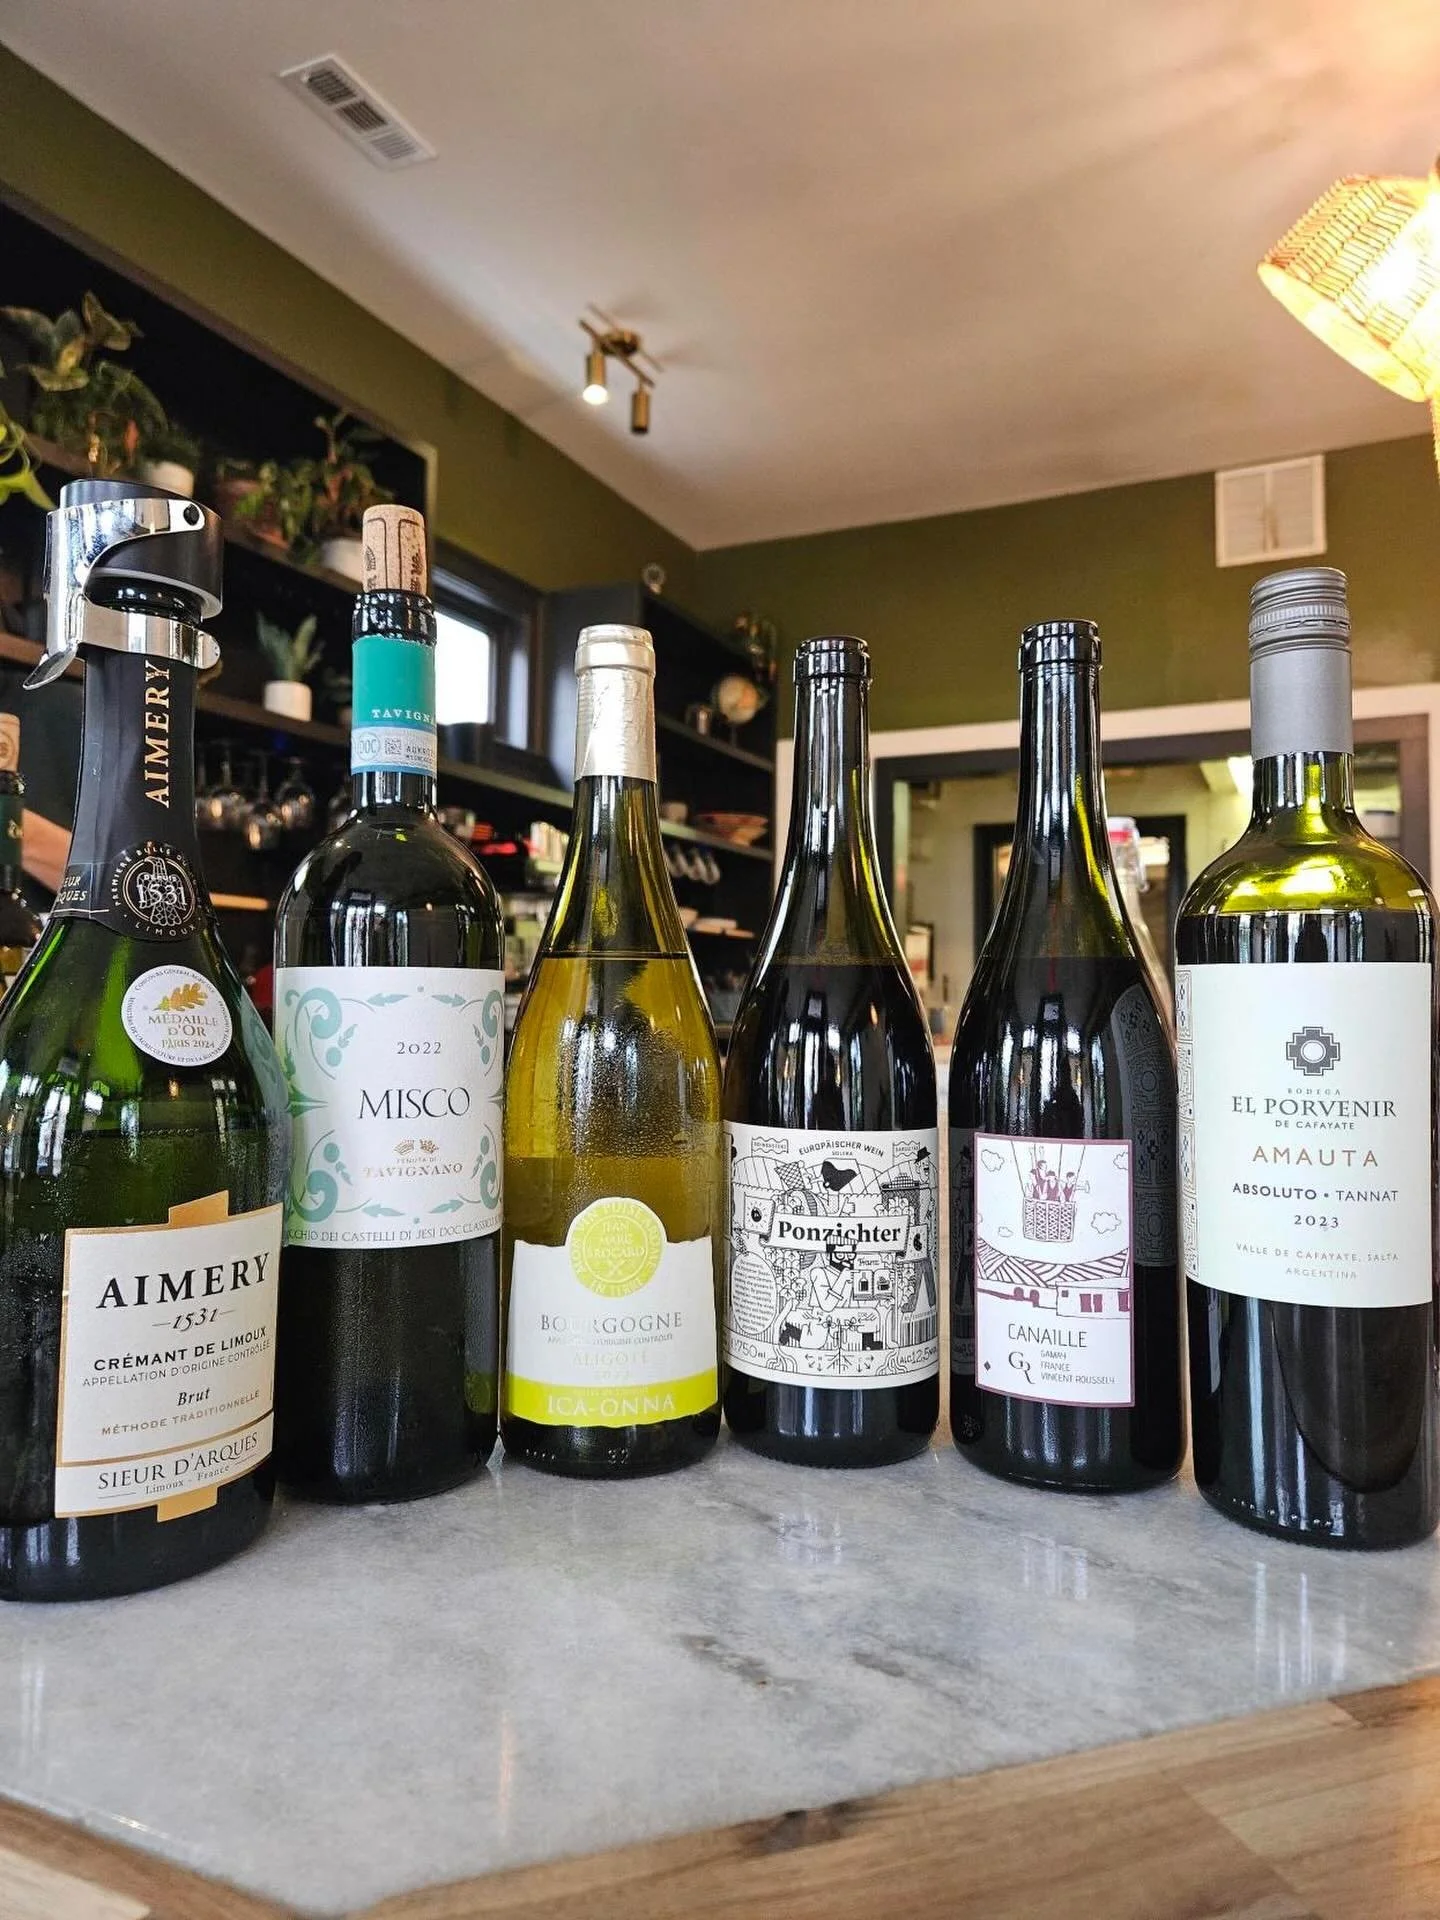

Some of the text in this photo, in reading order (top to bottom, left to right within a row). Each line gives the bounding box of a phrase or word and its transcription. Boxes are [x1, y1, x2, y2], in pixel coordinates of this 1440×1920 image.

[144, 659, 171, 808] AIMERY
[136, 883, 187, 909] 1531
[135, 923, 196, 937] LIMOUX
[147, 1012, 218, 1027] MÉDAILLE
[168, 1024, 207, 1037] D'OR
[162, 1039, 191, 1049] PARIS
[192, 1039, 216, 1049] 2024
[396, 1041, 442, 1055] 2022
[1287, 1087, 1342, 1097] BODEGA
[359, 1086, 471, 1120] MISCO
[1231, 1096, 1397, 1119] EL PORVENIR
[1275, 1119, 1356, 1131] DE CAFAYATE
[863, 1144, 884, 1158] WEIN
[1252, 1146, 1379, 1168] AMAUTA
[363, 1162, 463, 1178] TAVIGNANO
[1232, 1183, 1399, 1202] ABSOLUTO TANNAT
[1294, 1214, 1339, 1229] 2023
[321, 1231, 339, 1242] DEI
[341, 1230, 396, 1242] CASTELLI
[400, 1230, 412, 1241] DI
[416, 1227, 436, 1239] JESI
[778, 1220, 901, 1244] Ponzichter
[1236, 1243, 1269, 1256] VALLE
[1274, 1246, 1290, 1258] DE
[1367, 1251, 1400, 1263] SALTA
[95, 1252, 270, 1309] AIMERY
[1285, 1267, 1358, 1281] ARGENTINA
[172, 1308, 219, 1332] 1531
[541, 1311, 683, 1335] BORGOGNE
[1008, 1323, 1088, 1348] CANAILLE
[94, 1326, 268, 1372] CRÉMANT DE LIMOUX
[82, 1368, 167, 1388] APPELLATION
[170, 1355, 228, 1378] D'ORIGINE
[1041, 1360, 1071, 1372] FRANCE
[1041, 1371, 1073, 1383] VINCENT
[177, 1387, 211, 1406] Brut
[547, 1393, 676, 1417] ICA-ONNA
[101, 1389, 260, 1437] MÉTHODE TRADITIONNELLE
[98, 1431, 259, 1491] SIEUR D'ARQUES
[145, 1478, 184, 1496] Limoux
[197, 1463, 231, 1482] France
